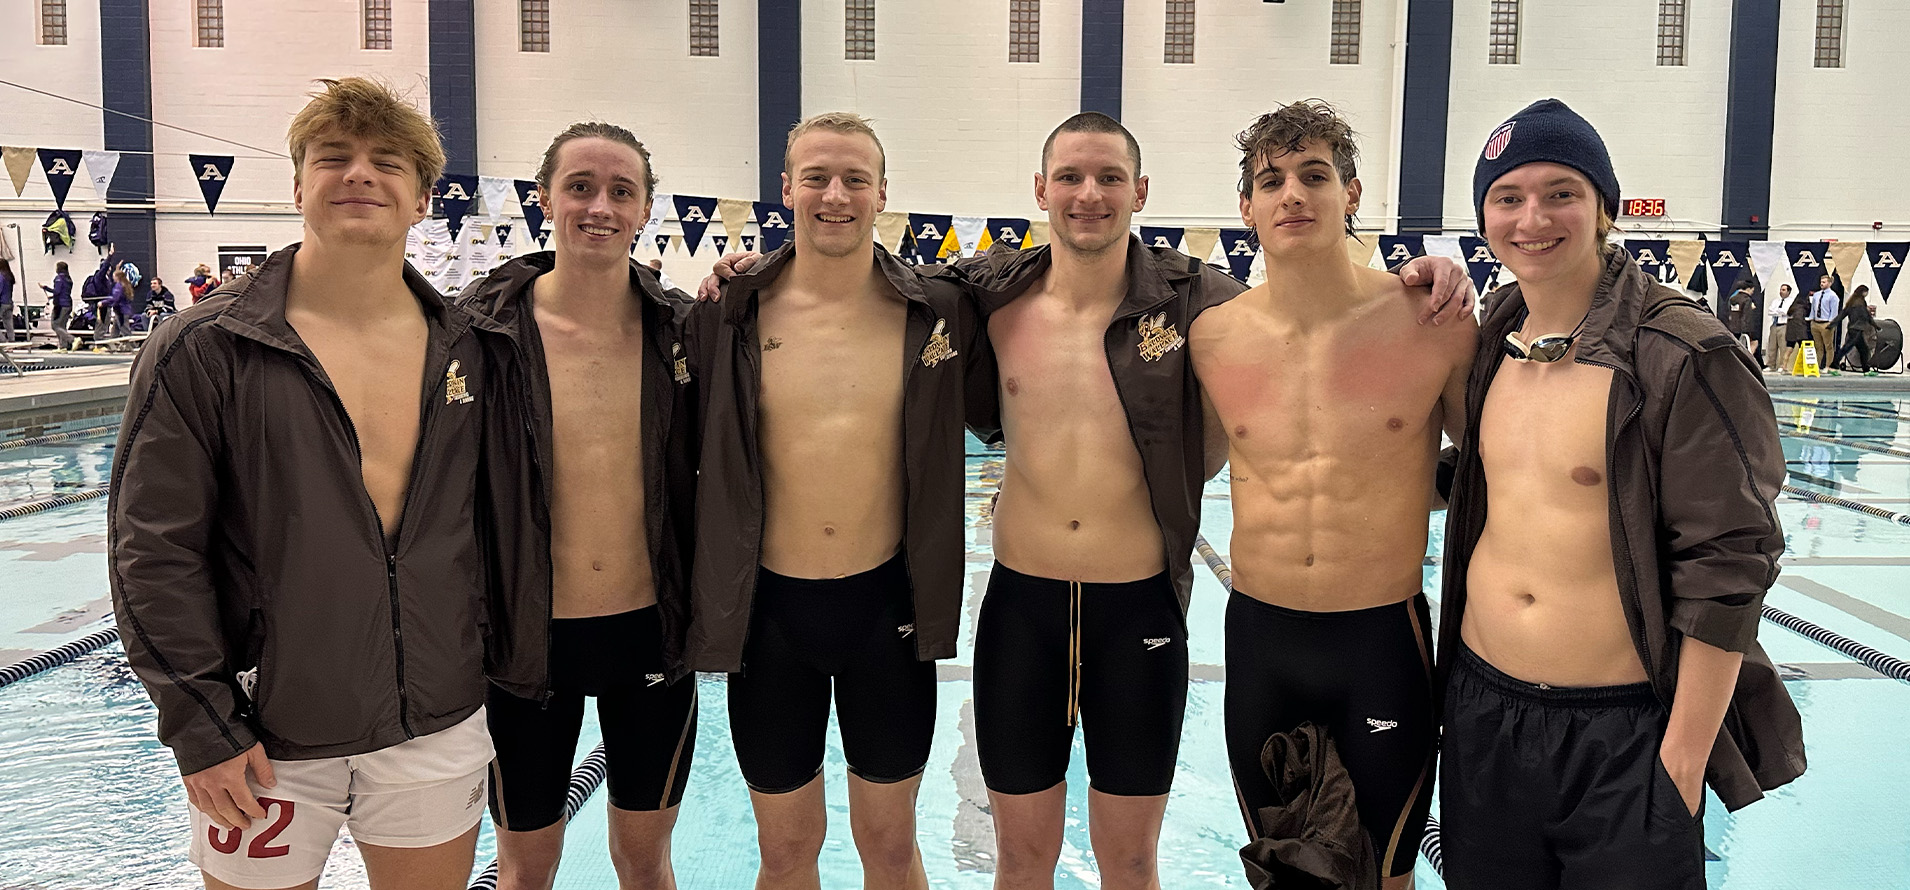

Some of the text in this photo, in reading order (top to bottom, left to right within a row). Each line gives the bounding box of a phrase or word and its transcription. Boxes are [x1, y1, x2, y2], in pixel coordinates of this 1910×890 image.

[48, 158, 75, 175] A
[199, 163, 226, 181] A
[443, 183, 470, 200] A
[682, 205, 709, 223] A
[1629, 200, 1663, 216] 18:36
[762, 212, 789, 229] A
[916, 223, 944, 240] A
[1000, 227, 1022, 243] A
[1229, 240, 1256, 256] A
[1387, 244, 1412, 260] A
[1468, 246, 1496, 262] A
[235, 256, 251, 265] OHIO
[1636, 249, 1660, 265] A
[1712, 251, 1741, 267] A
[1793, 250, 1820, 267] A
[1873, 252, 1901, 268] A
[1143, 636, 1171, 645] speedo
[1366, 717, 1398, 728] speedo
